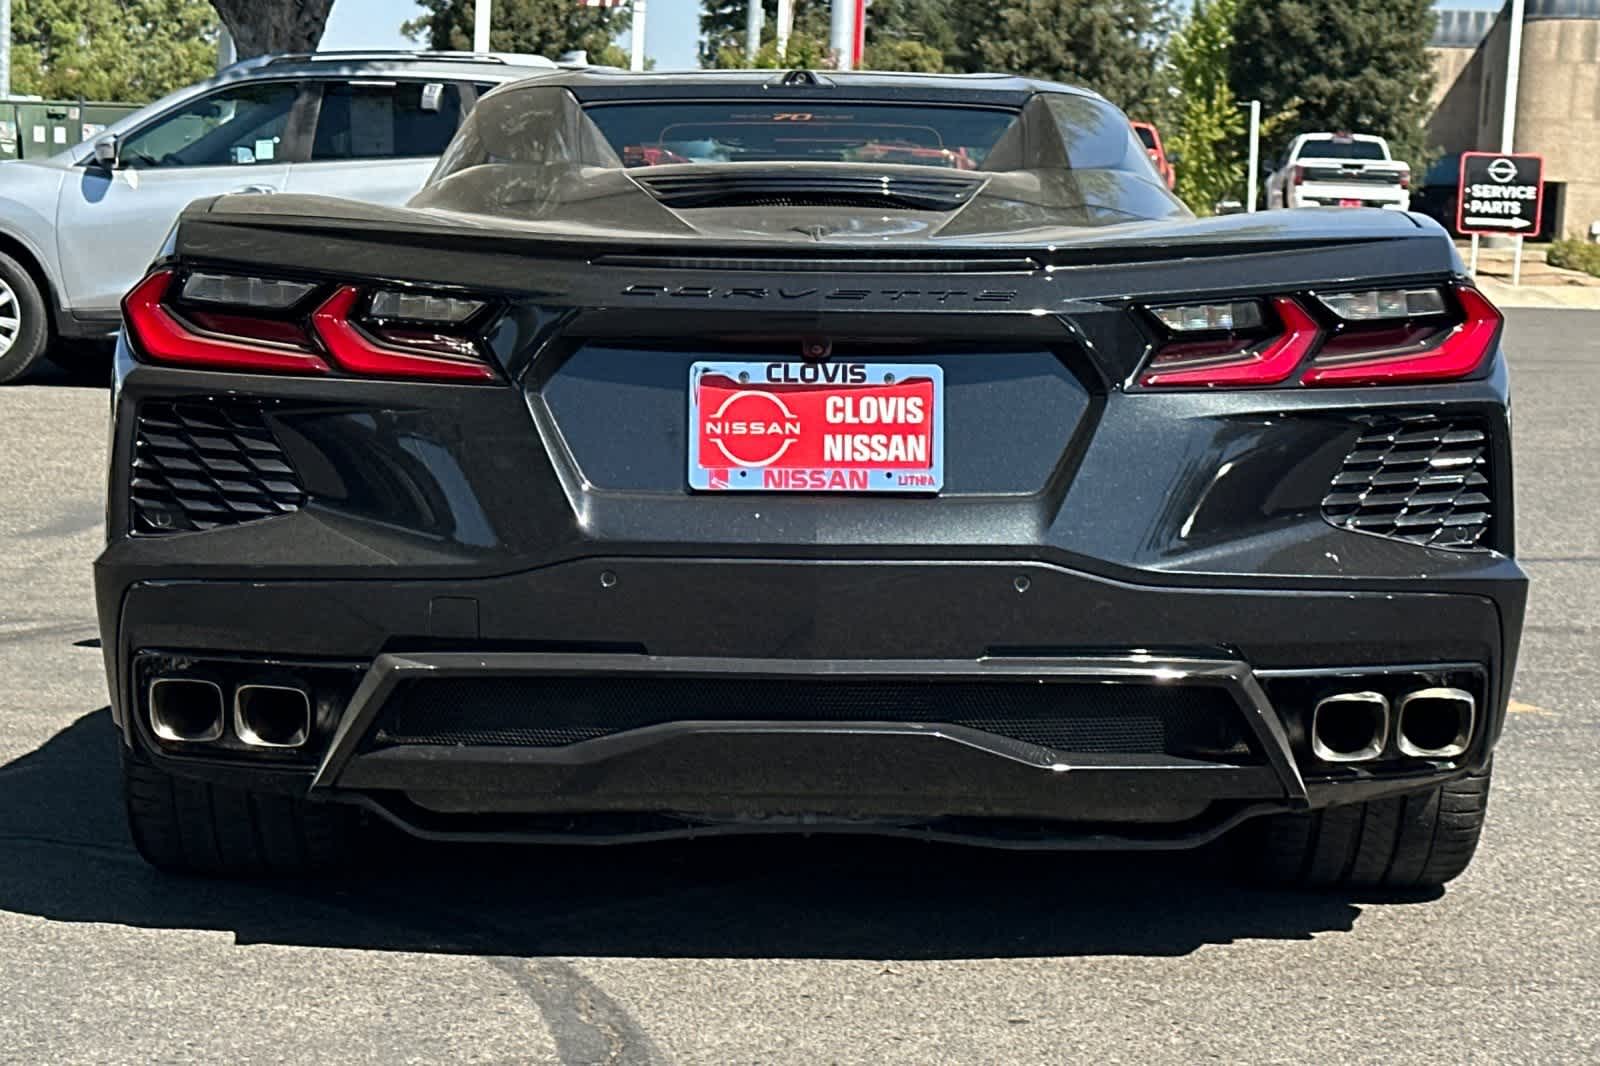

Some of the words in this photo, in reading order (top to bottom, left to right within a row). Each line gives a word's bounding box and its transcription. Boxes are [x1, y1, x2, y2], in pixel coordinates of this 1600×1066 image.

[1471, 184, 1537, 199] SERVICE
[1470, 200, 1521, 214] PARTS
[620, 284, 1018, 304] CORVETTE
[766, 363, 867, 383] CLOVIS
[825, 396, 924, 424] CLOVIS
[705, 421, 801, 436] NISSAN
[823, 434, 926, 462] NISSAN
[763, 470, 868, 490] NISSAN
